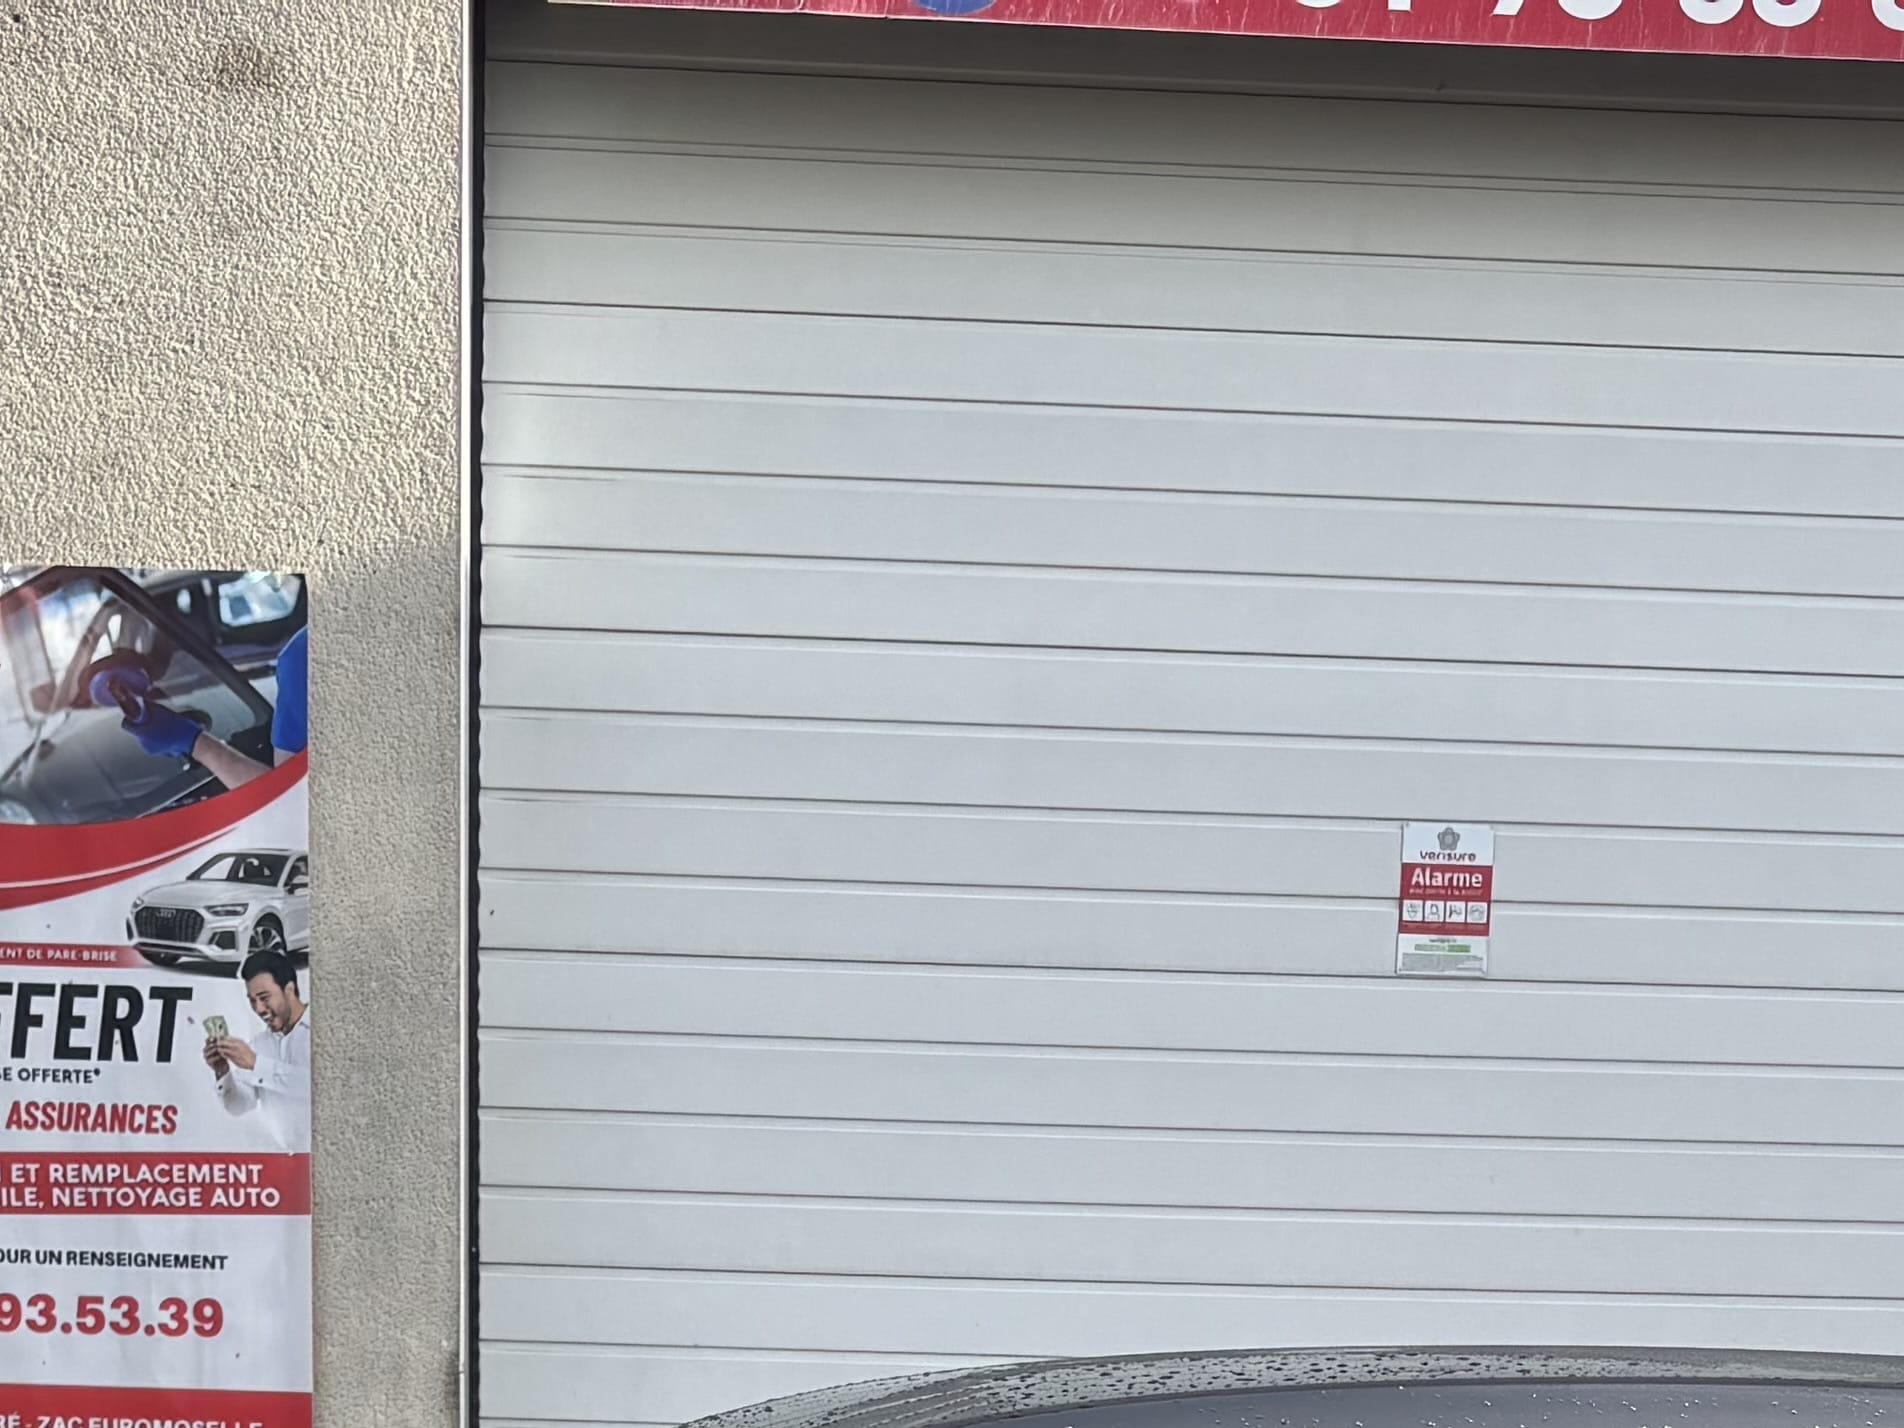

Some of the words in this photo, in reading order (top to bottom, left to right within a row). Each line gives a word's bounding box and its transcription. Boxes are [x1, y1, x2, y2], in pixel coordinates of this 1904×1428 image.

[1419, 850, 1477, 862] verisure
[1411, 867, 1483, 888] Alarme
[27, 948, 43, 960] DE
[47, 949, 118, 962] PARE-BRISE
[5, 1100, 179, 1135] ASSURANCES
[11, 1163, 40, 1183] ET
[49, 1163, 263, 1184] REMPLACEMENT
[52, 1187, 202, 1207] NETTOYAGE
[210, 1187, 280, 1208] AUTO
[35, 1249, 62, 1266] UN
[66, 1250, 229, 1271] RENSEIGNEMENT
